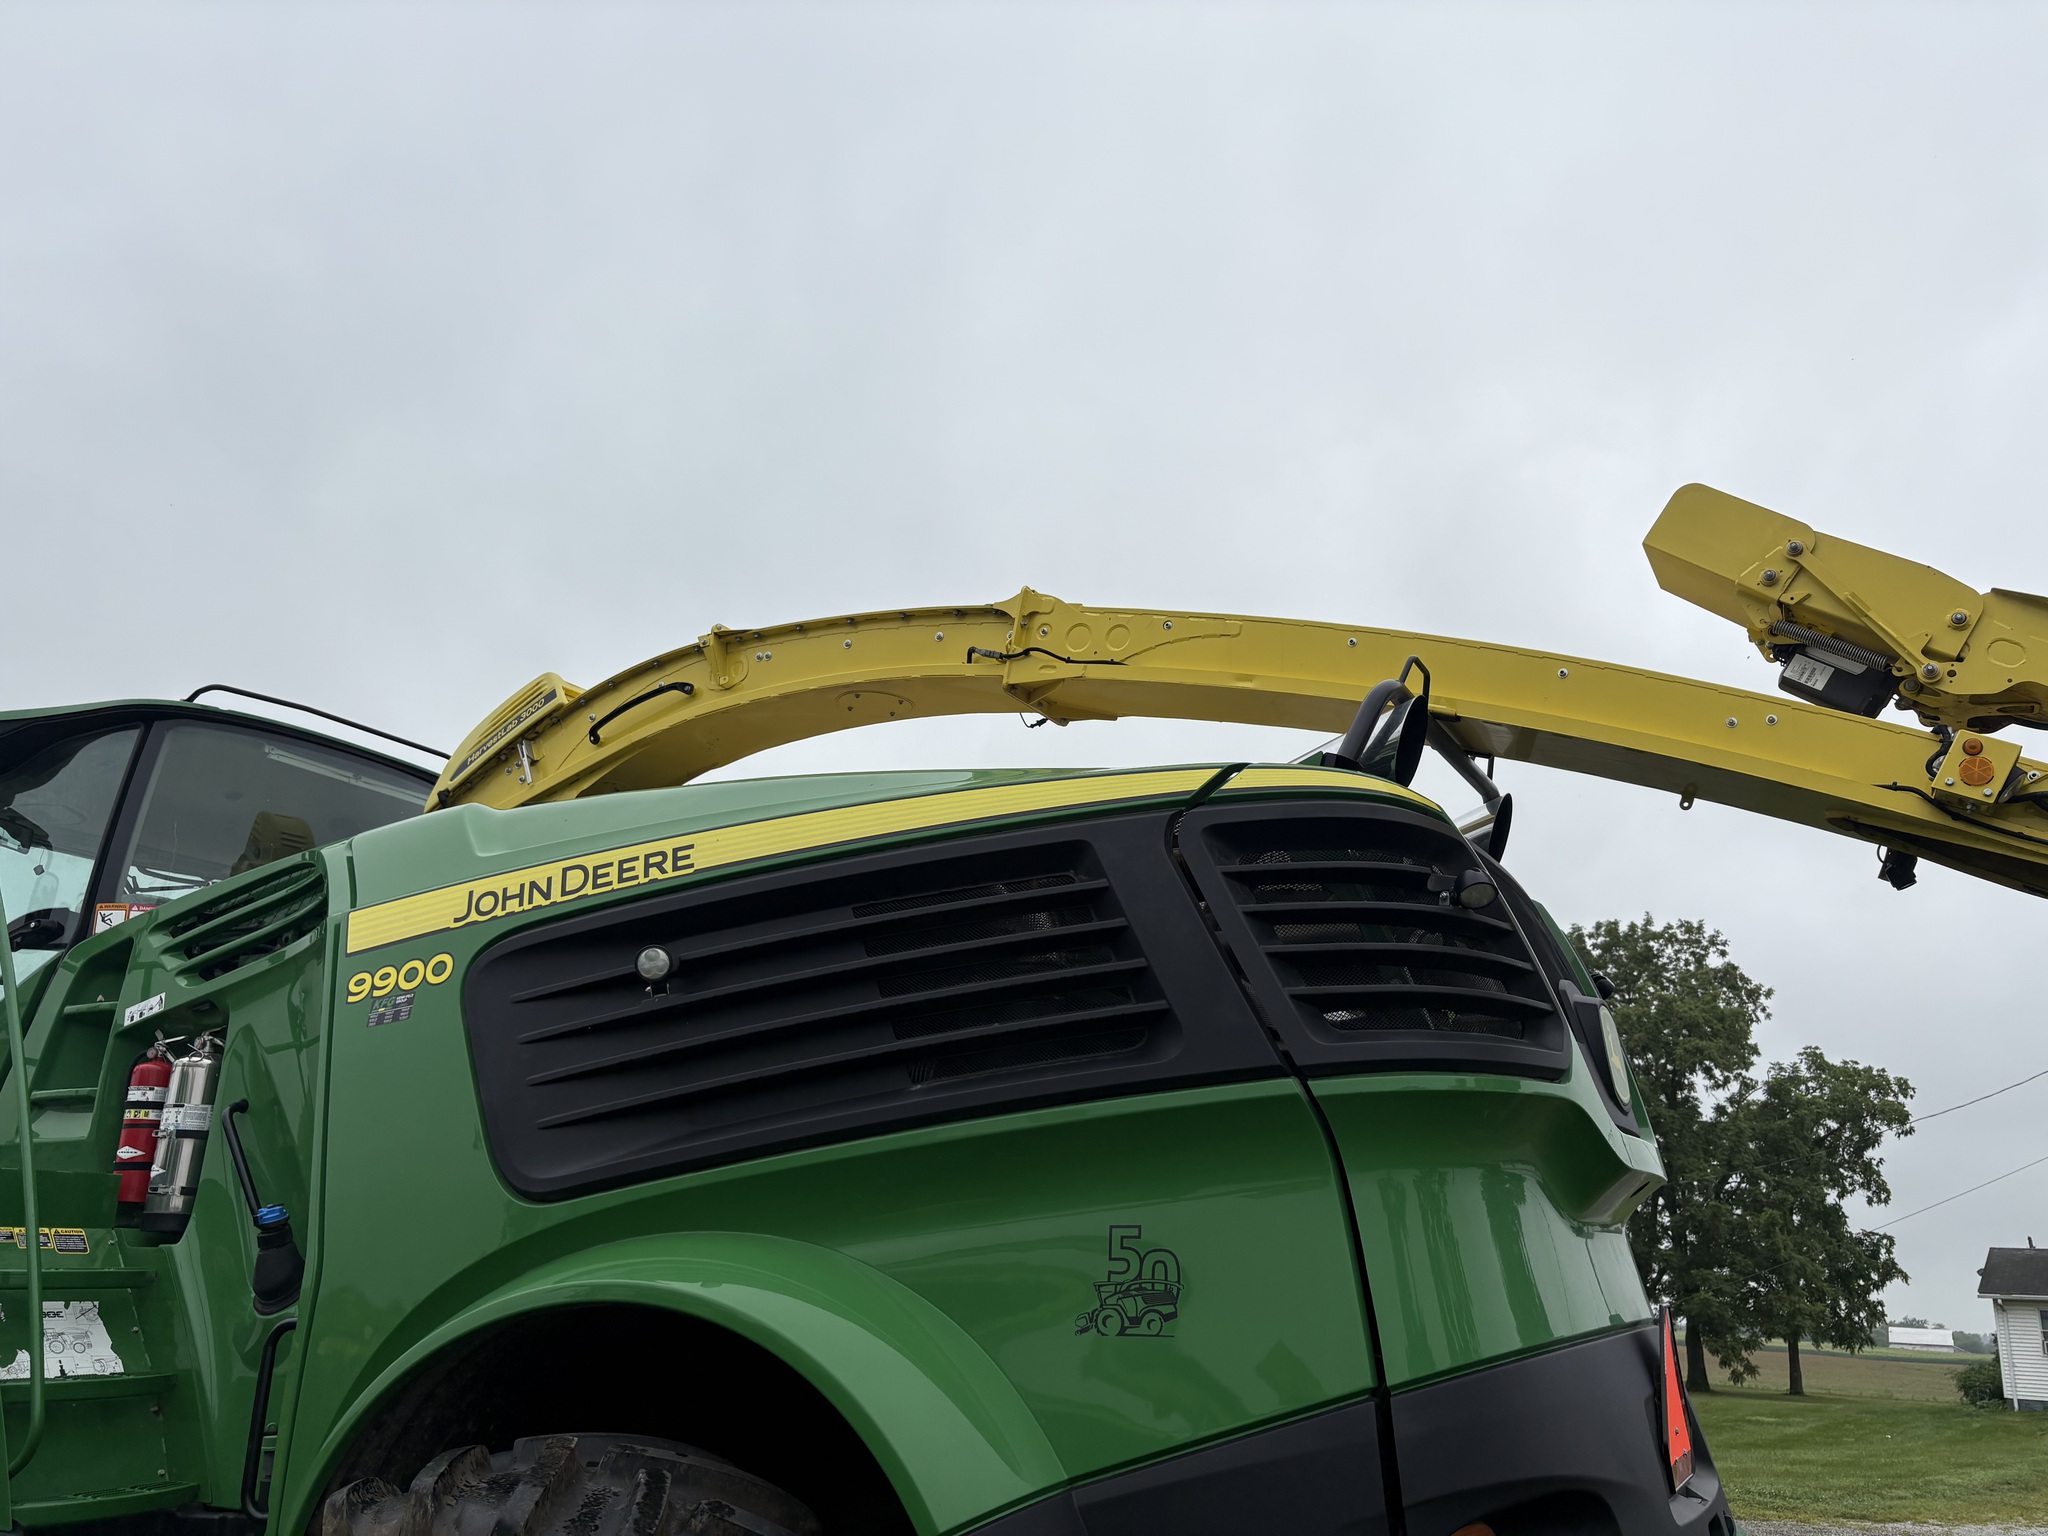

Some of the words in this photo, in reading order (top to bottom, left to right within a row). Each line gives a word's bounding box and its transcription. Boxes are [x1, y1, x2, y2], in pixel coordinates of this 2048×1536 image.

[467, 720, 518, 765] HarvestLab
[520, 698, 545, 721] 3000
[453, 876, 552, 924] JOHN
[560, 843, 696, 898] DEERE
[347, 952, 455, 1004] 9900
[373, 997, 396, 1010] KFG
[1108, 1225, 1181, 1303] 50
